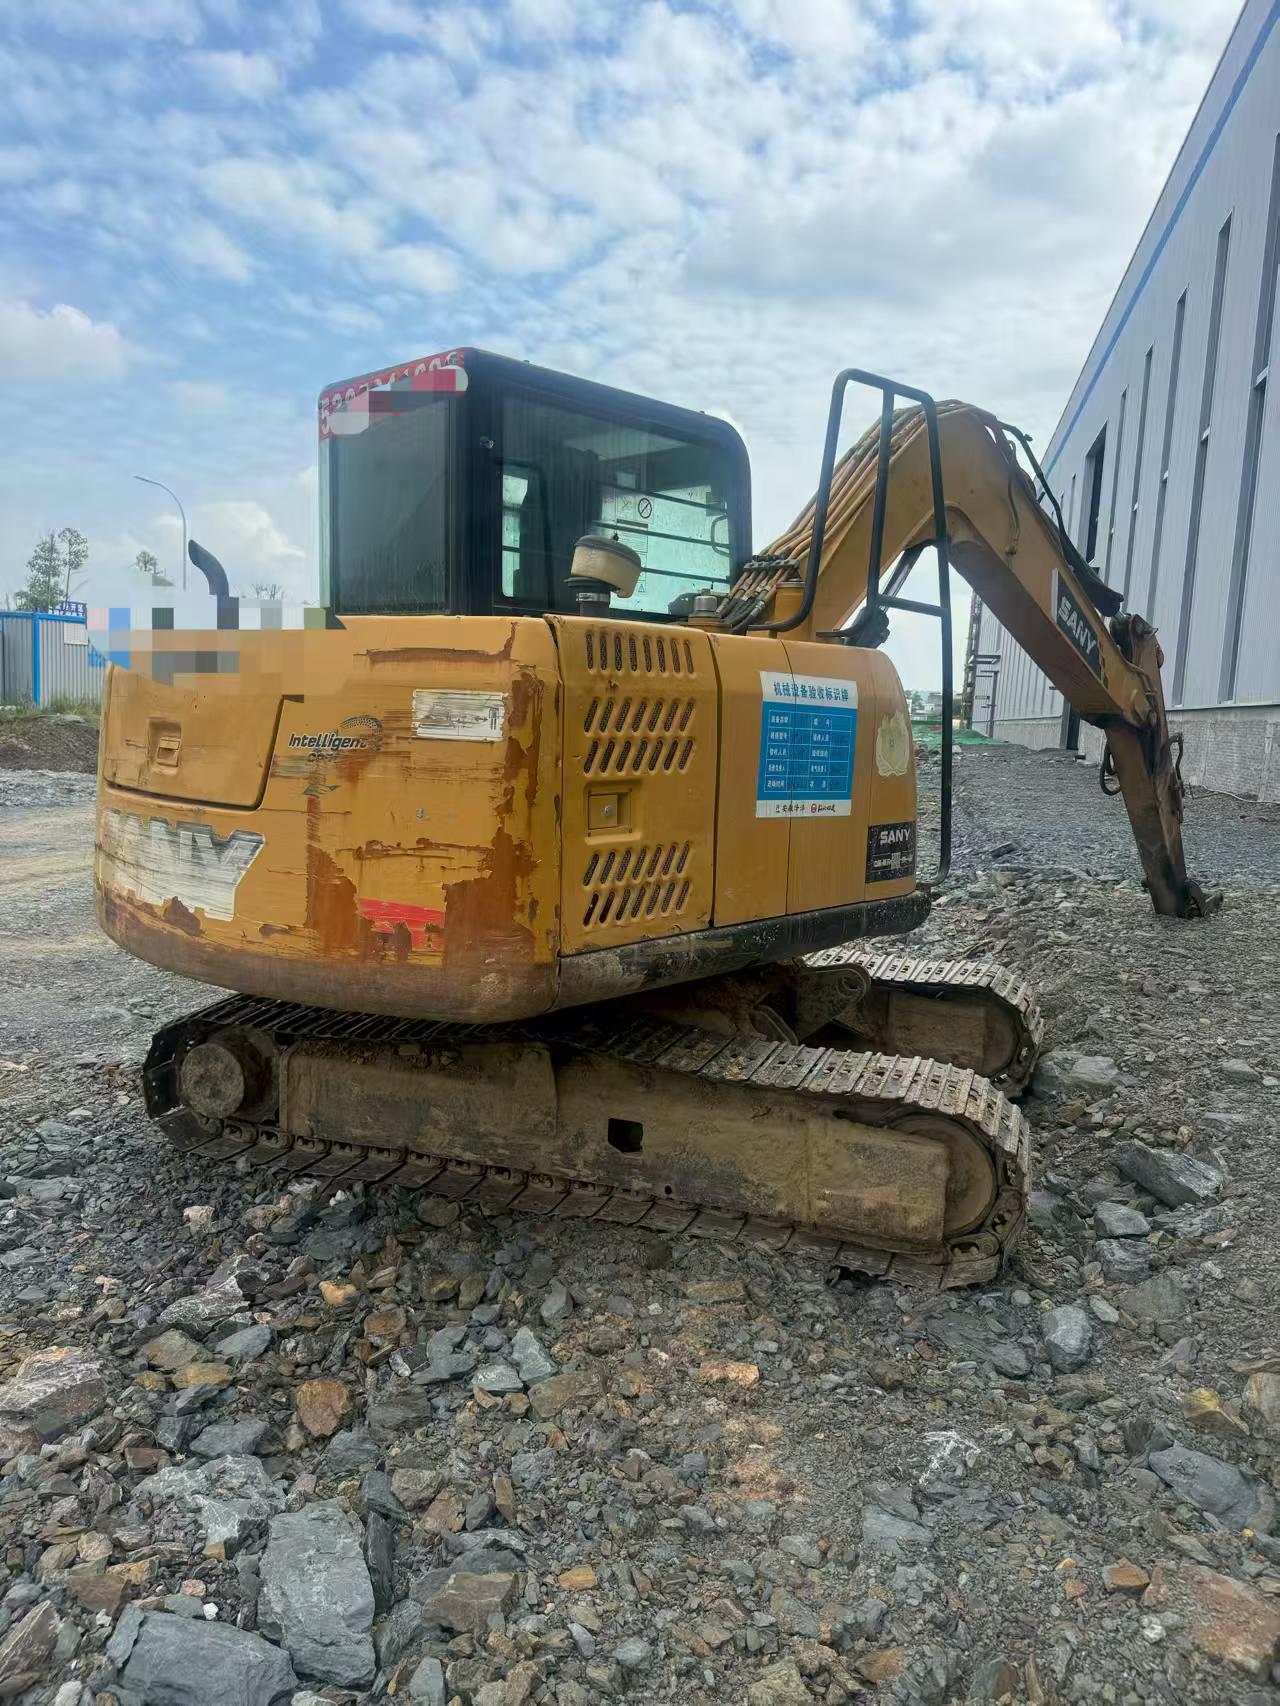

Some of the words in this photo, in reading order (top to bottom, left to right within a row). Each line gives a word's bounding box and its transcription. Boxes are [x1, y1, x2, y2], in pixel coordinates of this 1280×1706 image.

[1059, 596, 1096, 655] SANY
[773, 681, 849, 701] 机械设备验收标识牌
[880, 829, 910, 845] SANY
